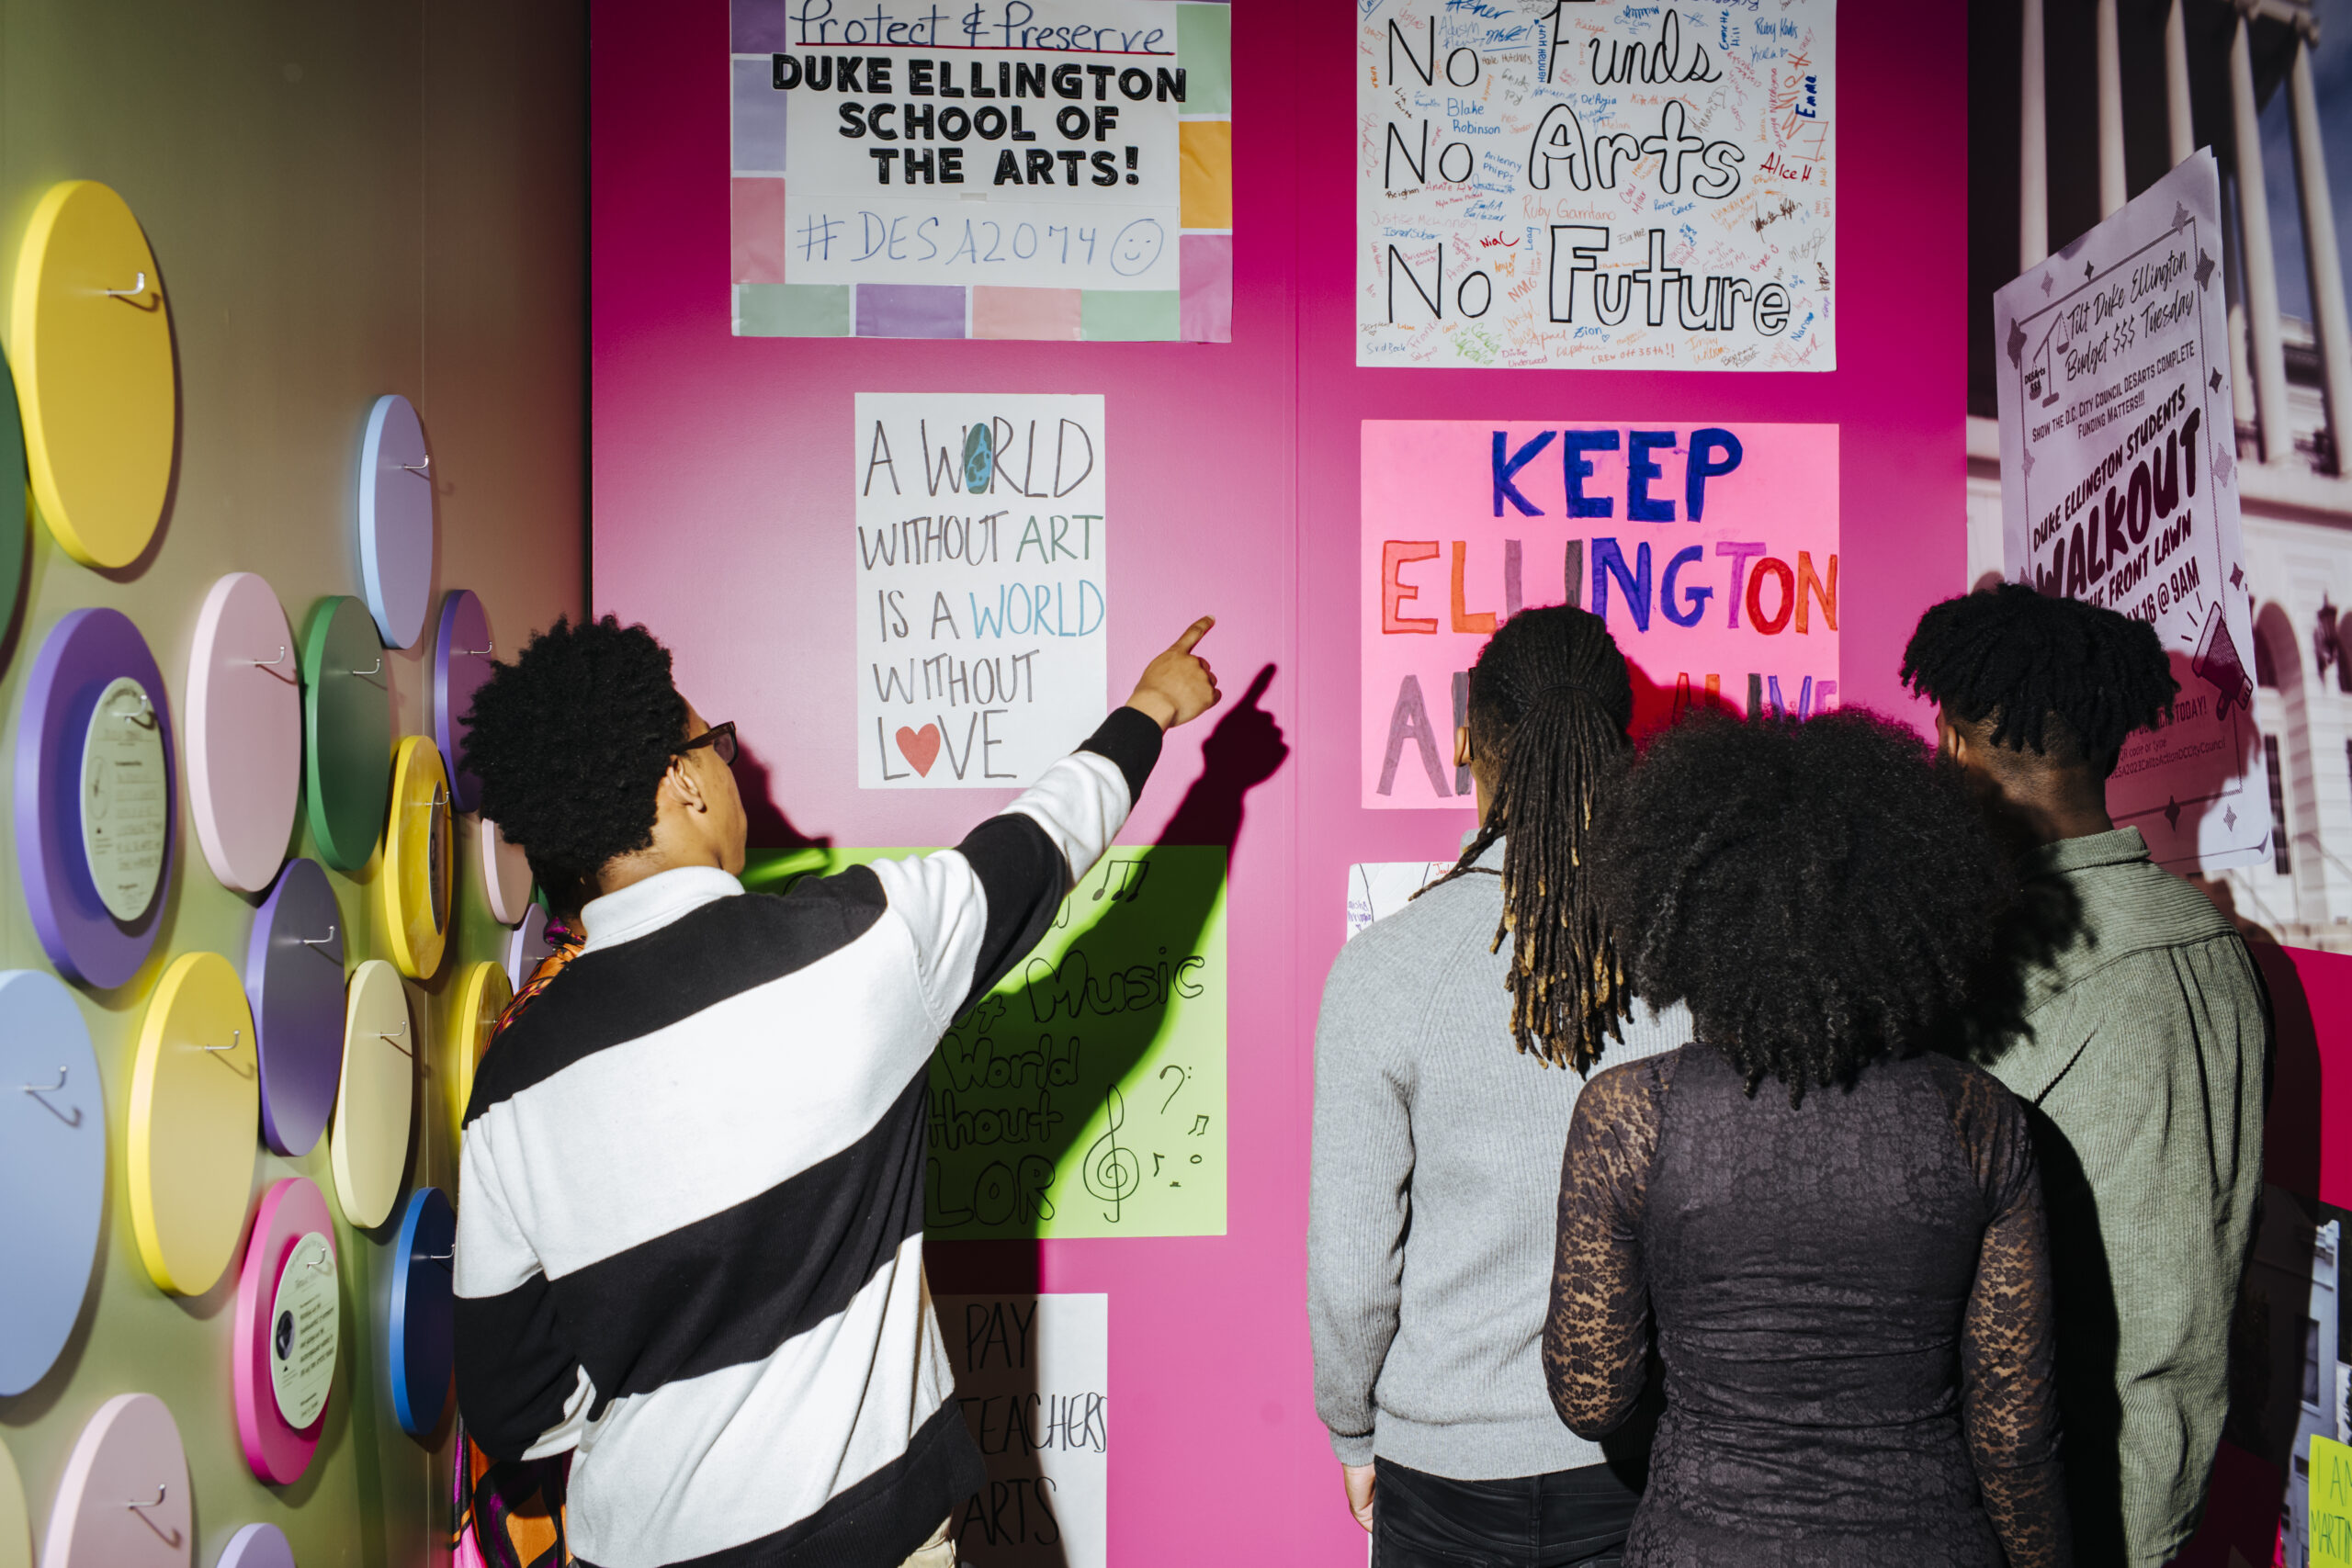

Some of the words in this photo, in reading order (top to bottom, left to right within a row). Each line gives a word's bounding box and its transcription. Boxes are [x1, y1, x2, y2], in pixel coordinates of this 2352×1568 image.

[789, 0, 950, 47] Protect
[962, 3, 989, 48] &
[993, 2, 1171, 55] Preserve
[1388, 15, 1479, 87] No
[1541, 0, 1723, 85] Funds
[772, 52, 892, 94] DUKE
[908, 58, 1187, 102] ELLINGTON
[1447, 97, 1485, 118] Blake
[838, 102, 1036, 141] SCHOOL
[1056, 105, 1119, 141] OF
[1385, 119, 1473, 189] No
[1529, 100, 1745, 199] Arts
[1453, 118, 1500, 135] Robinson
[869, 147, 964, 185] THE
[993, 146, 1140, 186] ARTS!
[1759, 152, 1798, 180] Alice
[1479, 235, 1500, 248] Nia
[1522, 194, 1550, 232] Ruby
[1388, 243, 1491, 323] No
[1550, 224, 1791, 336] Future
[2066, 301, 2089, 341] Tilt
[2095, 286, 2125, 329] Duke
[2130, 250, 2188, 303] Ellington
[1573, 326, 1602, 339] Zion
[2064, 333, 2110, 382] Budget
[2113, 316, 2136, 356] $$$
[2140, 289, 2195, 341] Tuesday
[2052, 418, 2065, 434] THE
[2065, 409, 2078, 426] D.C.
[864, 419, 901, 497] A
[1492, 427, 1744, 524] KEEP
[2033, 504, 2062, 553] DUKE
[2064, 444, 2123, 522] ELLINGTON
[2126, 382, 2186, 461] STUDENTS
[2035, 407, 2201, 598] WALKOUT
[858, 511, 1010, 571] WITHOUT
[1016, 514, 1104, 565] ART
[2109, 545, 2150, 607] FRONT
[2154, 508, 2192, 567] LAWN
[2170, 555, 2201, 604] 9AM
[878, 590, 909, 642] IS
[931, 591, 961, 640] A
[969, 580, 1105, 639] WORLD
[872, 649, 1040, 706] WITHOUT
[1025, 947, 1205, 1024] Music
[939, 1032, 1080, 1093] World
[966, 1300, 1038, 1373] PAY
[956, 1476, 1058, 1547] ARTS
